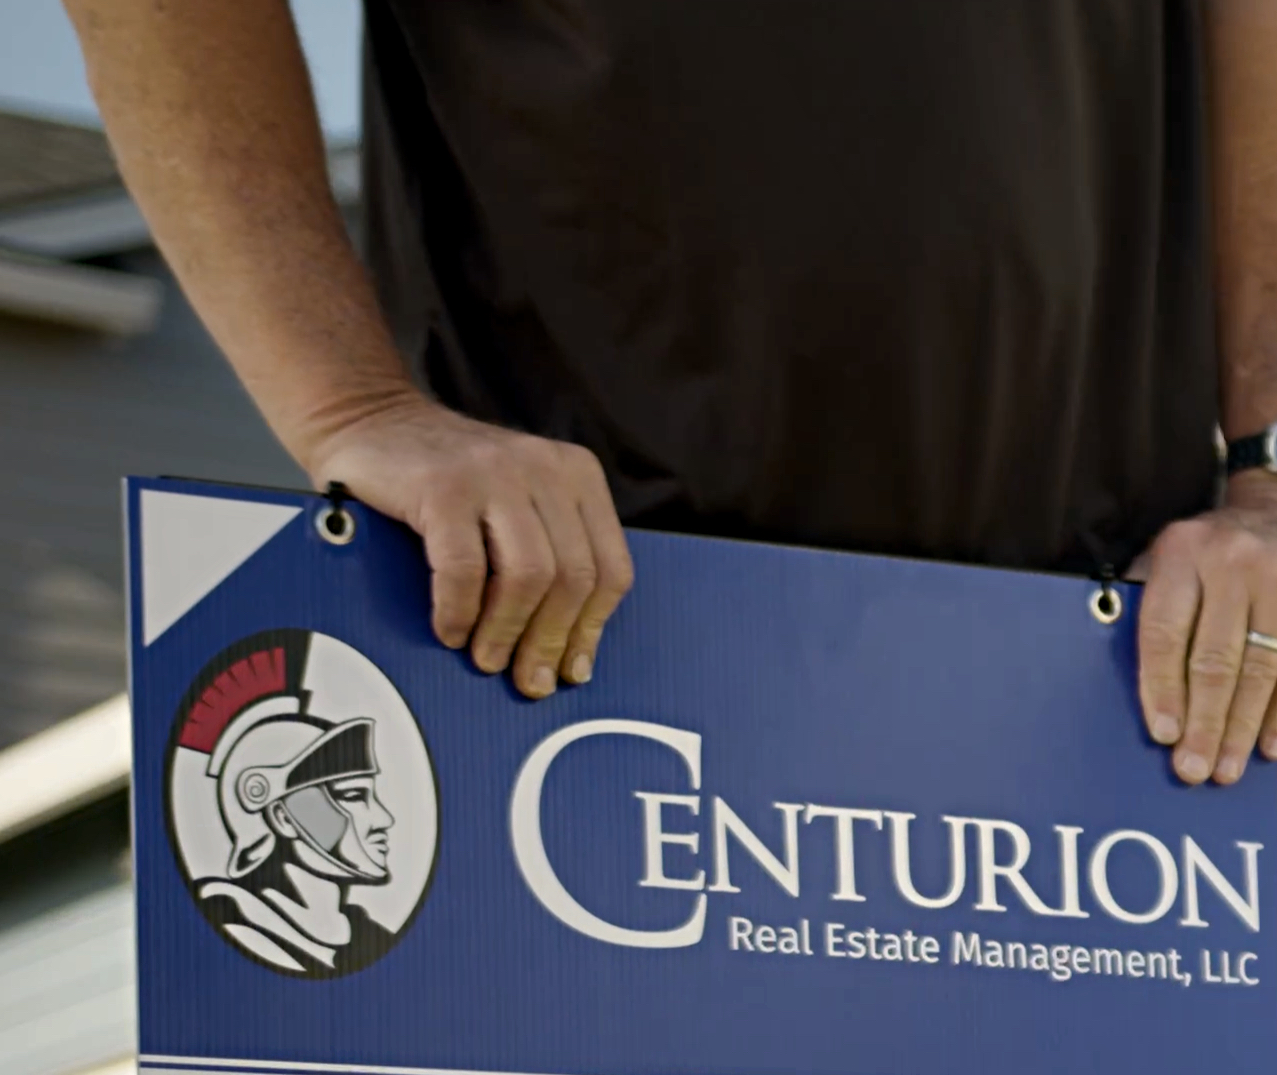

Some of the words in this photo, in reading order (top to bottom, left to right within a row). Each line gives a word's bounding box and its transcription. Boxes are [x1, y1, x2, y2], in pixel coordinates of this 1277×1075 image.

[509, 718, 1264, 949] CENTURION
[729, 916, 814, 956] Real
[825, 922, 940, 964] Estate
[952, 931, 1193, 987] Management,
[1202, 949, 1261, 986] LLC
